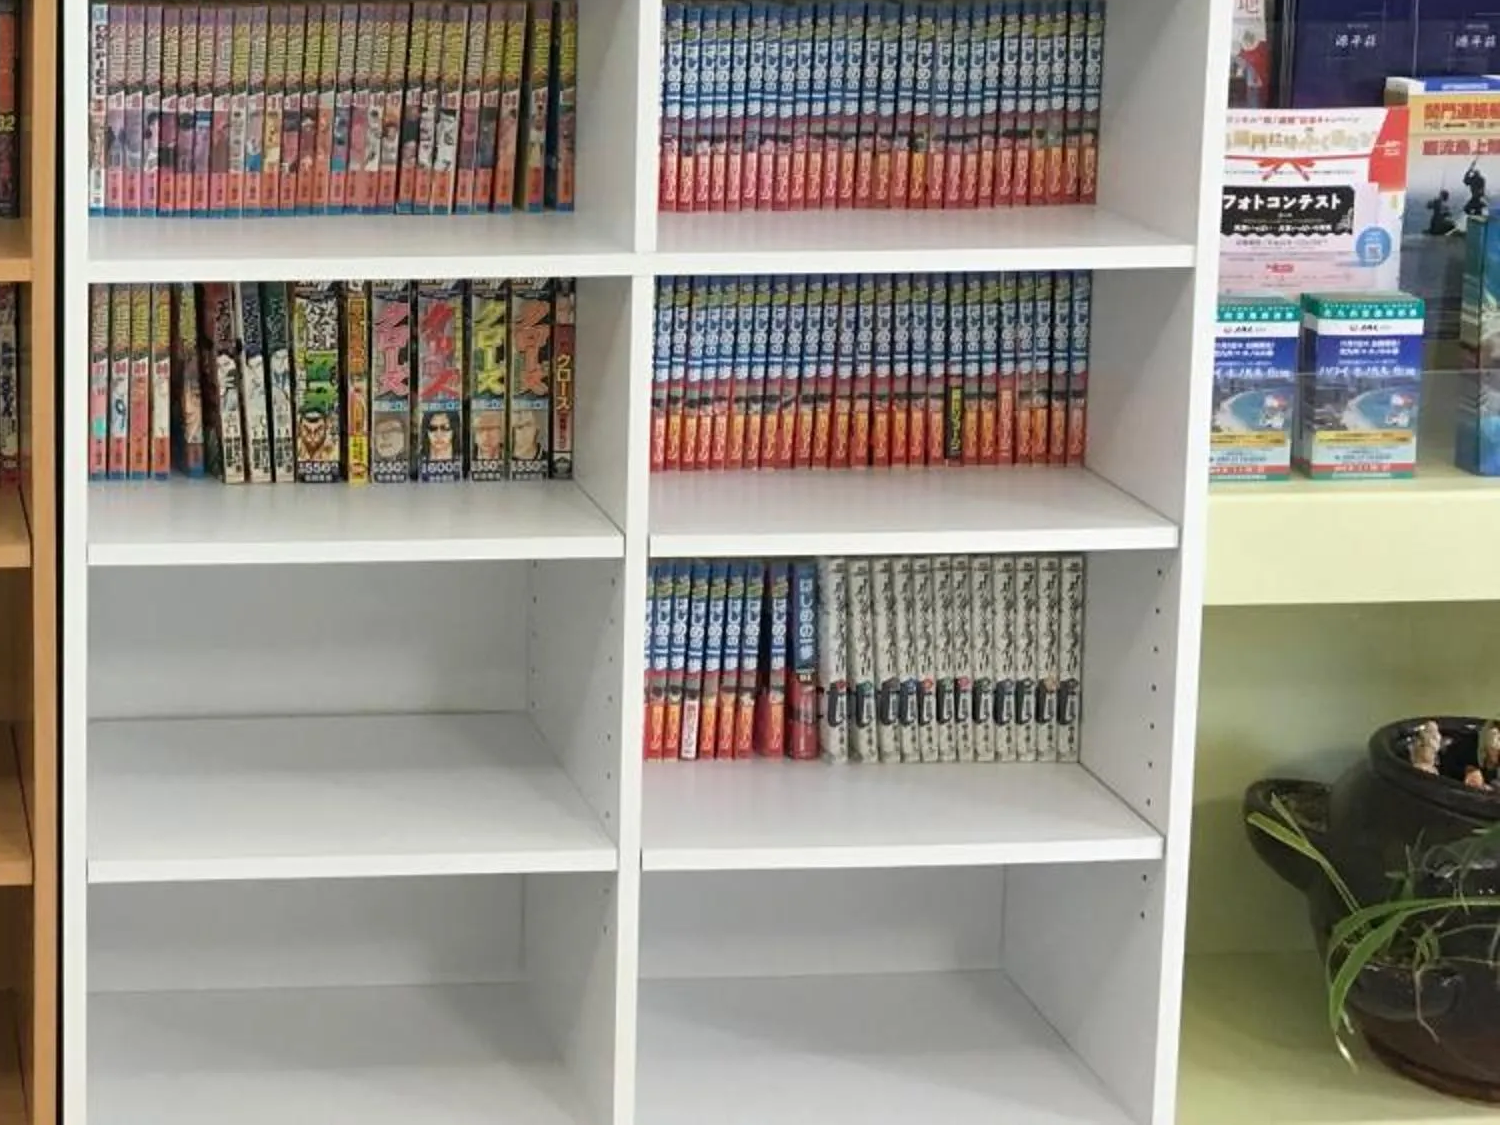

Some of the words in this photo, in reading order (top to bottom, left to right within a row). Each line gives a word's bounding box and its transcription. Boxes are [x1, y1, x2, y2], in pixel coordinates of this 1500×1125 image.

[1223, 193, 1342, 211] フォトコンテスト
